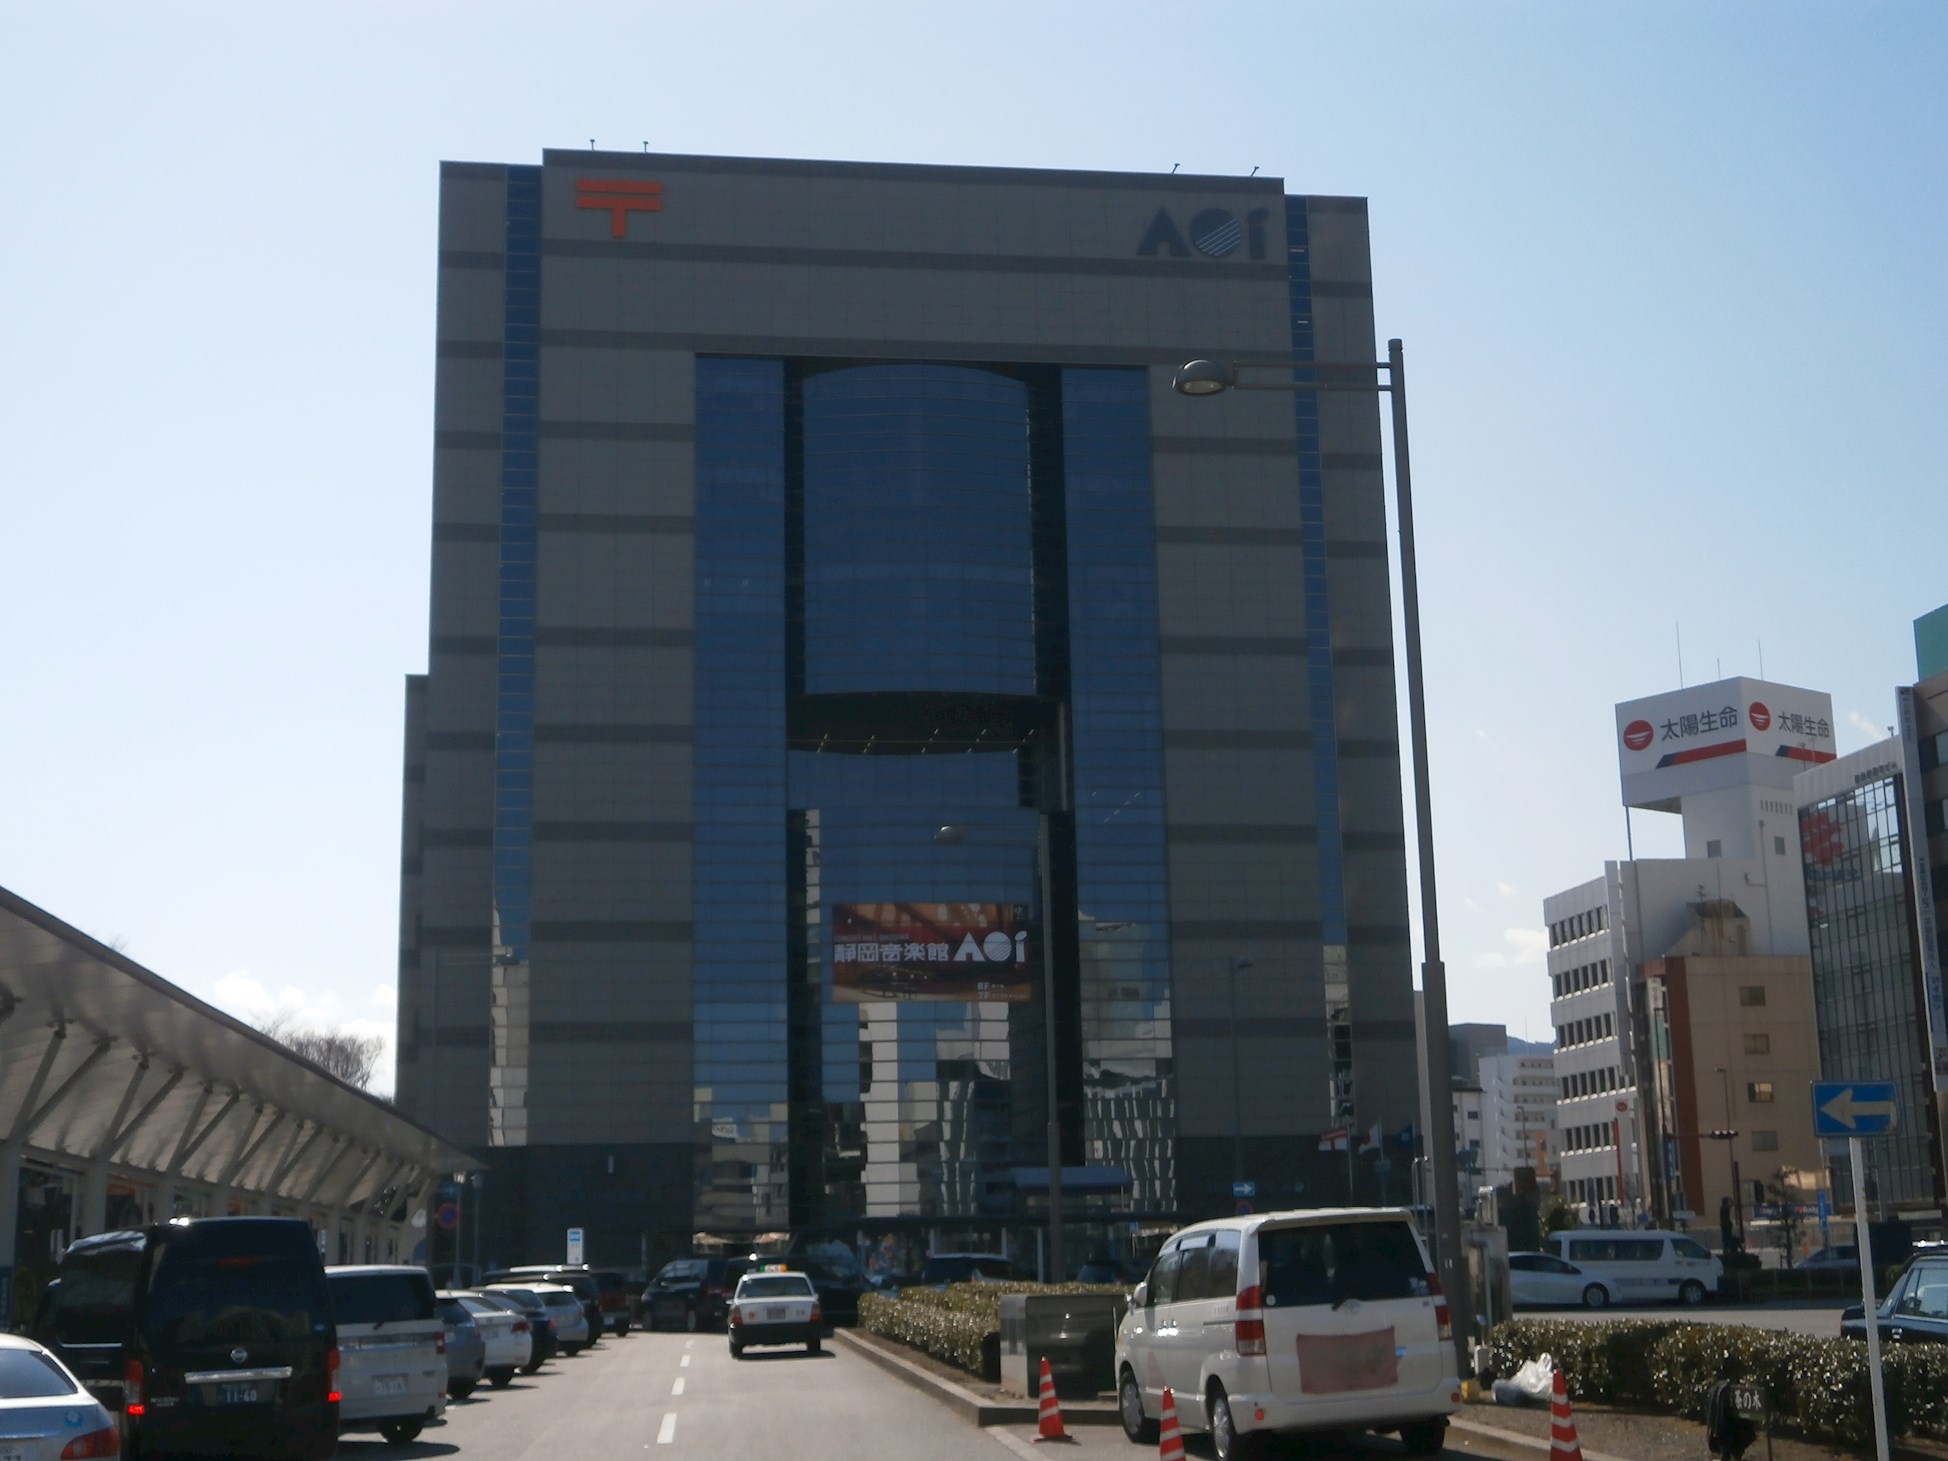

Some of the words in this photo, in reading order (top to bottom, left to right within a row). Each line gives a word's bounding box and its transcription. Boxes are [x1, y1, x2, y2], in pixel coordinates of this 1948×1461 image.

[1660, 705, 1738, 742] 太陽生命
[1777, 710, 1830, 739] 太陽生命
[834, 942, 949, 963] 静岡音楽館
[1734, 1388, 1762, 1411] 茶の木
